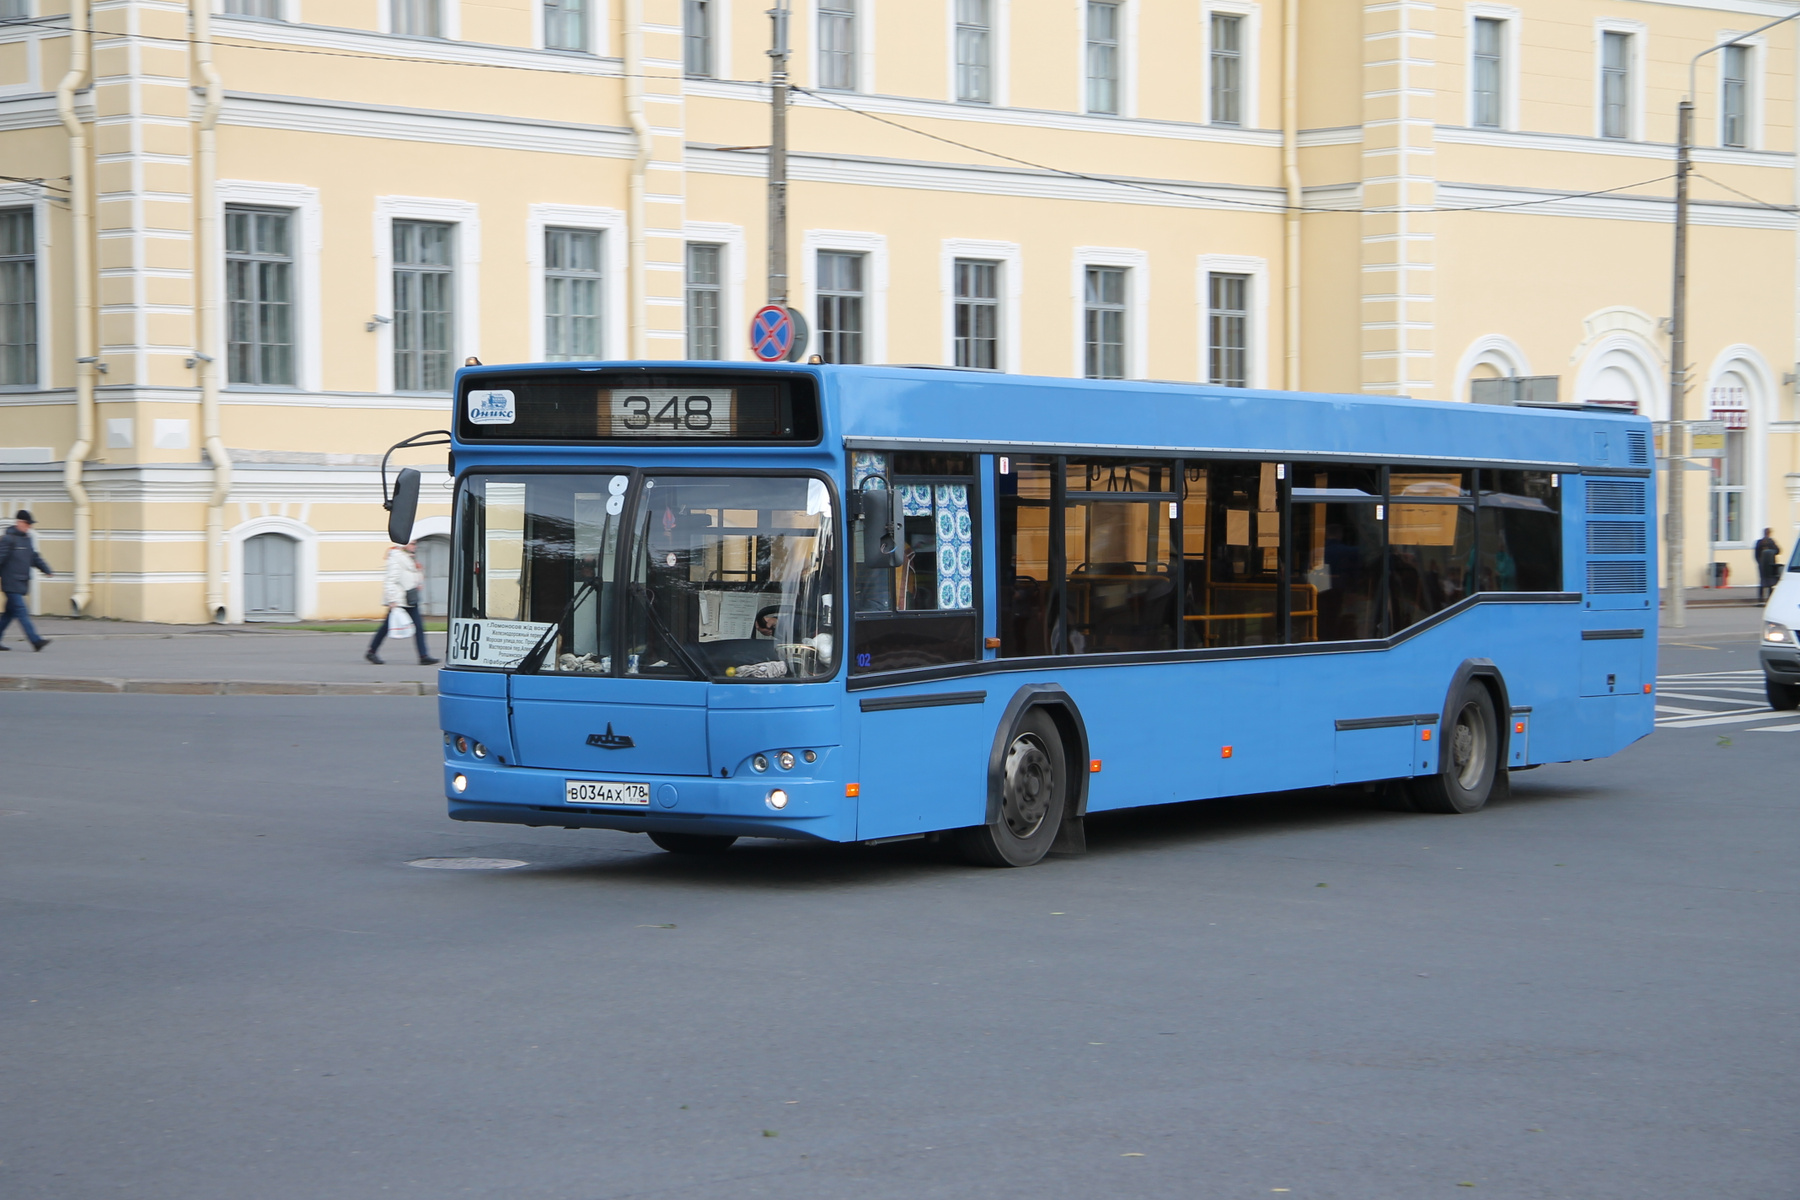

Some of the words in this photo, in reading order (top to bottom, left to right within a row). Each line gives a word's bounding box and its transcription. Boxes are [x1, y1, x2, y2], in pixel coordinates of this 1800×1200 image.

[470, 408, 514, 418] Оникс
[623, 395, 713, 431] 348
[452, 622, 481, 661] 348
[625, 785, 646, 798] 178
